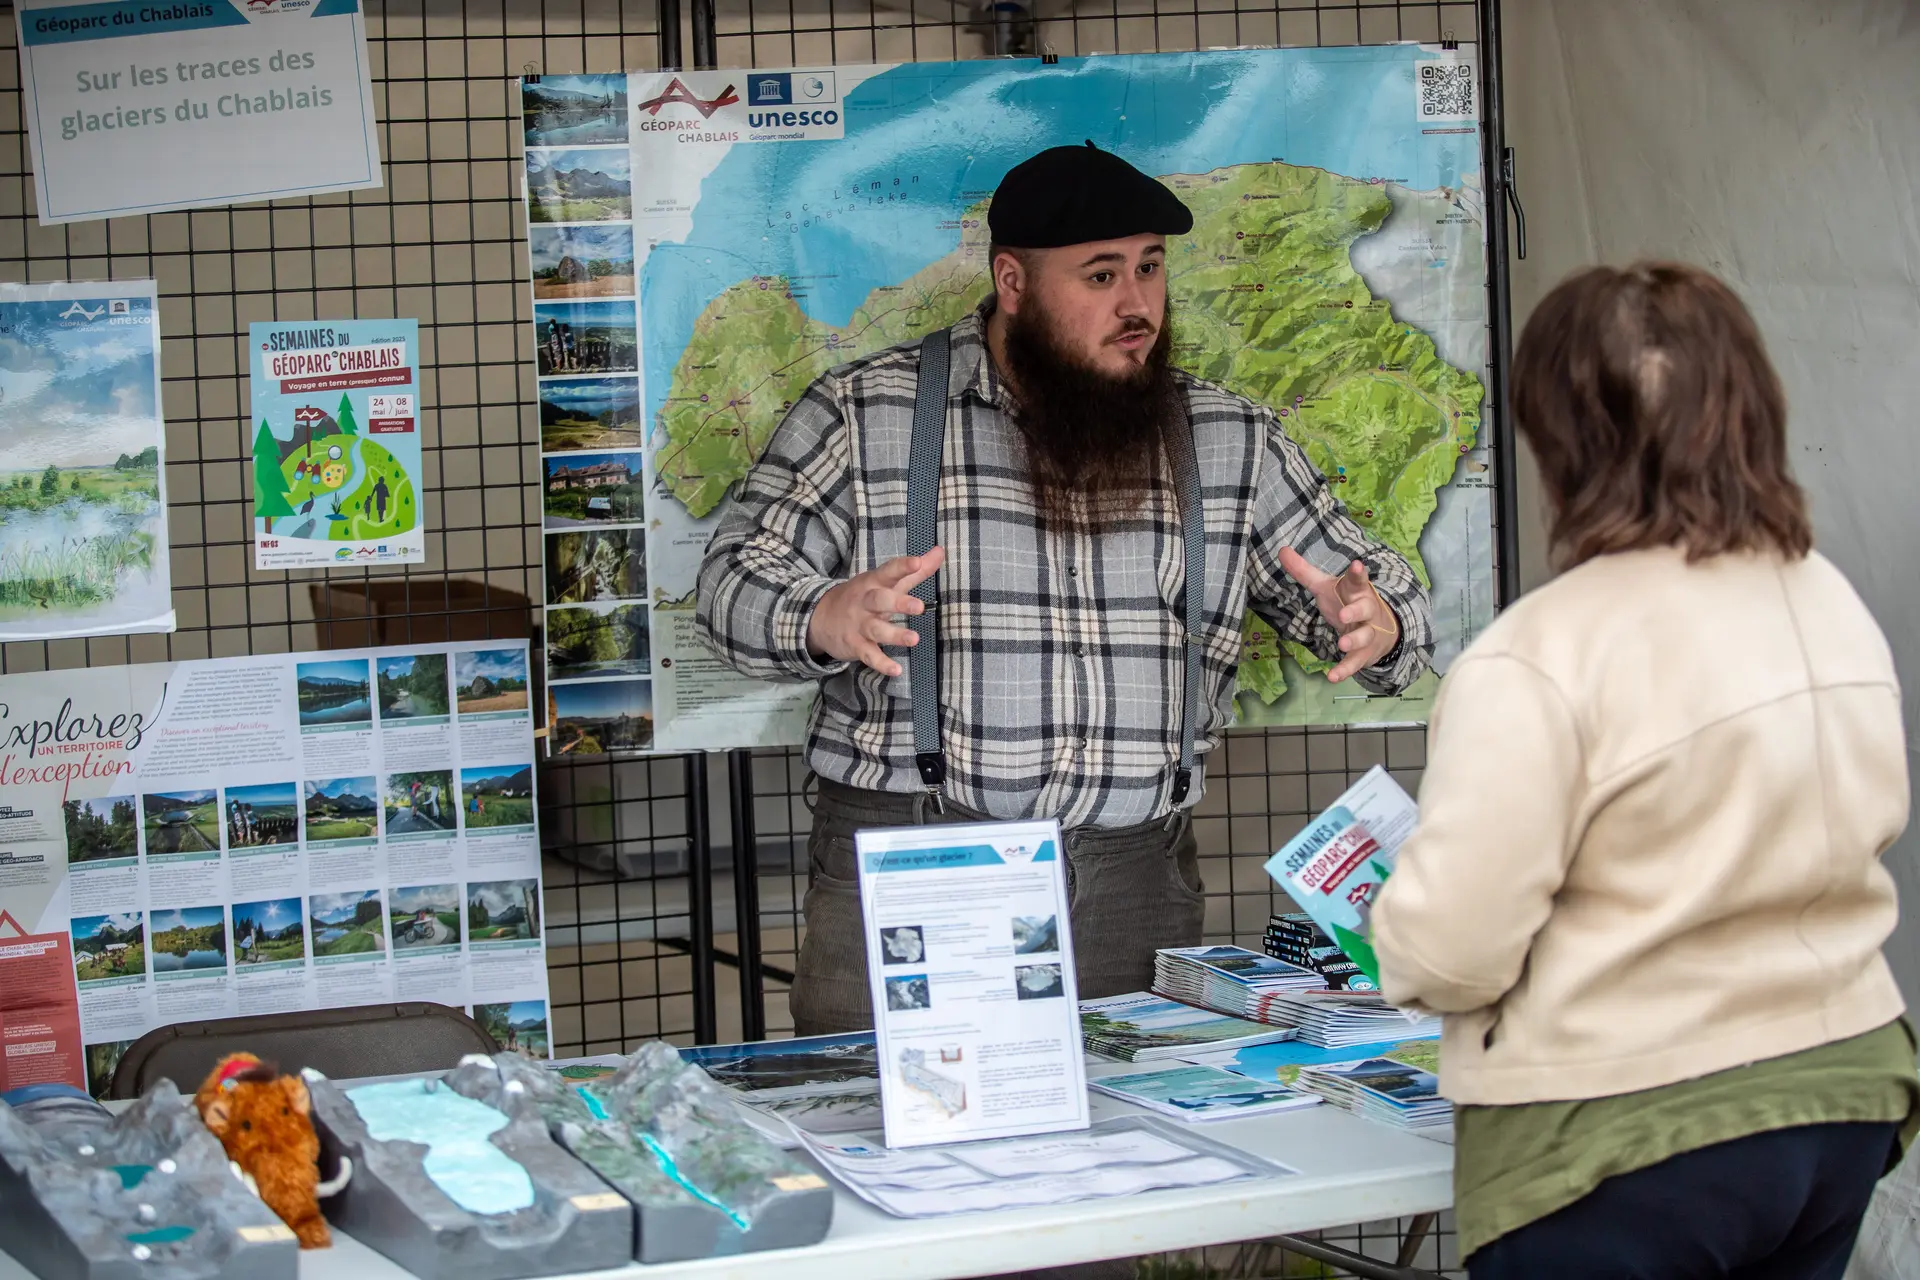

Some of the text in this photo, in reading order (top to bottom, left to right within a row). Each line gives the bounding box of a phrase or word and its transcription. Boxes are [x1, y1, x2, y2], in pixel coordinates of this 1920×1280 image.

[281, 0, 310, 8] unesco
[36, 3, 213, 33] Géoparc du Chablais
[76, 50, 315, 92] Sur les traces des
[61, 85, 333, 141] glaciers du Chablais
[748, 110, 838, 128] unesco
[641, 120, 700, 132] GÉOPARC
[678, 132, 739, 143] CHABLAIS
[749, 133, 777, 141] Géoparc
[834, 175, 919, 200] Léman
[790, 203, 855, 233] Geneva
[109, 316, 151, 326] unesco
[270, 328, 335, 351] SEMAINES
[338, 333, 350, 346] DU
[273, 353, 331, 376] GÉOPARC
[339, 348, 400, 371] CHABLAIS
[288, 382, 316, 391] Voyage
[395, 408, 408, 416] juin
[38, 740, 123, 756] UN TERRITOIRE
[1285, 824, 1335, 873] SEMAINES
[1302, 842, 1348, 887] GÉOPARC
[1346, 962, 1359, 970] CAR
